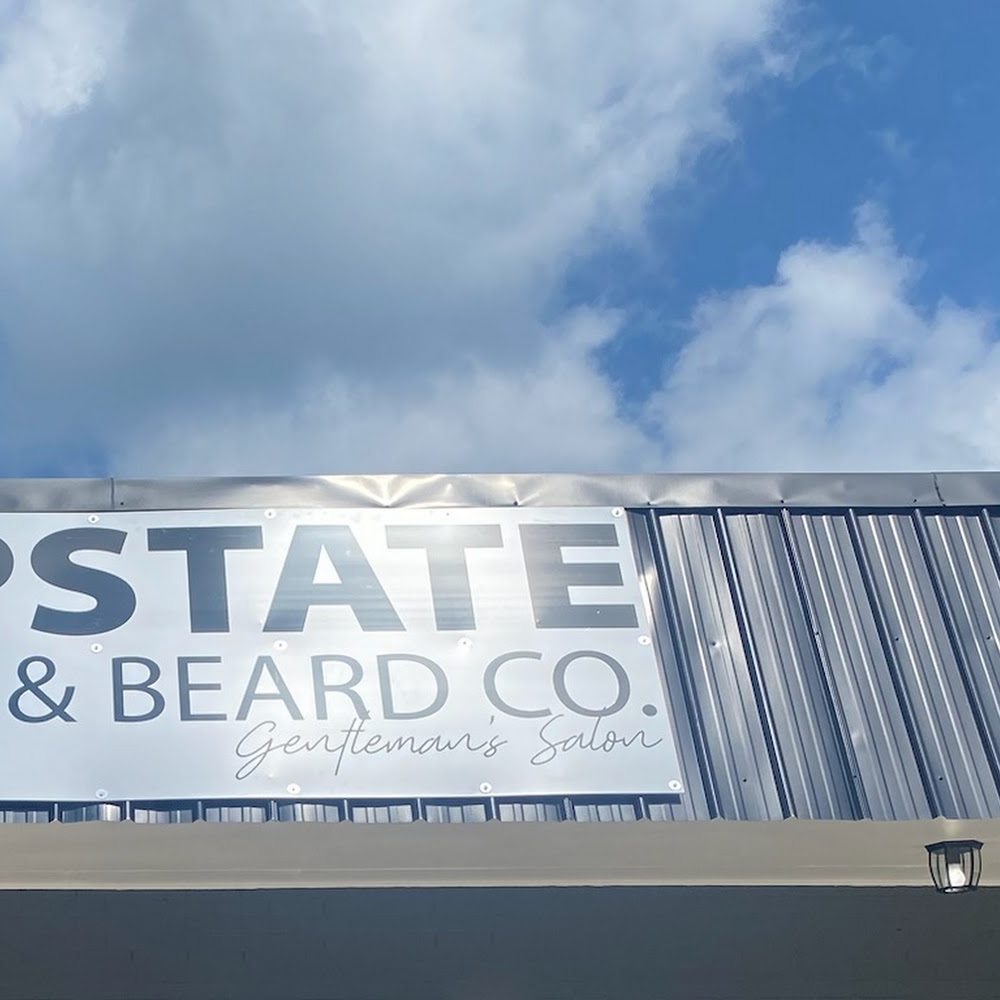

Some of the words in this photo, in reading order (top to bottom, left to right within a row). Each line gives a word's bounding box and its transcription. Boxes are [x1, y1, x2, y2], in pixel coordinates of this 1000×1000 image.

[7, 653, 78, 725] &
[111, 651, 450, 724] BEARD
[482, 649, 659, 720] CO.
[234, 710, 508, 781] Gentleman's
[529, 708, 664, 766] Salon
